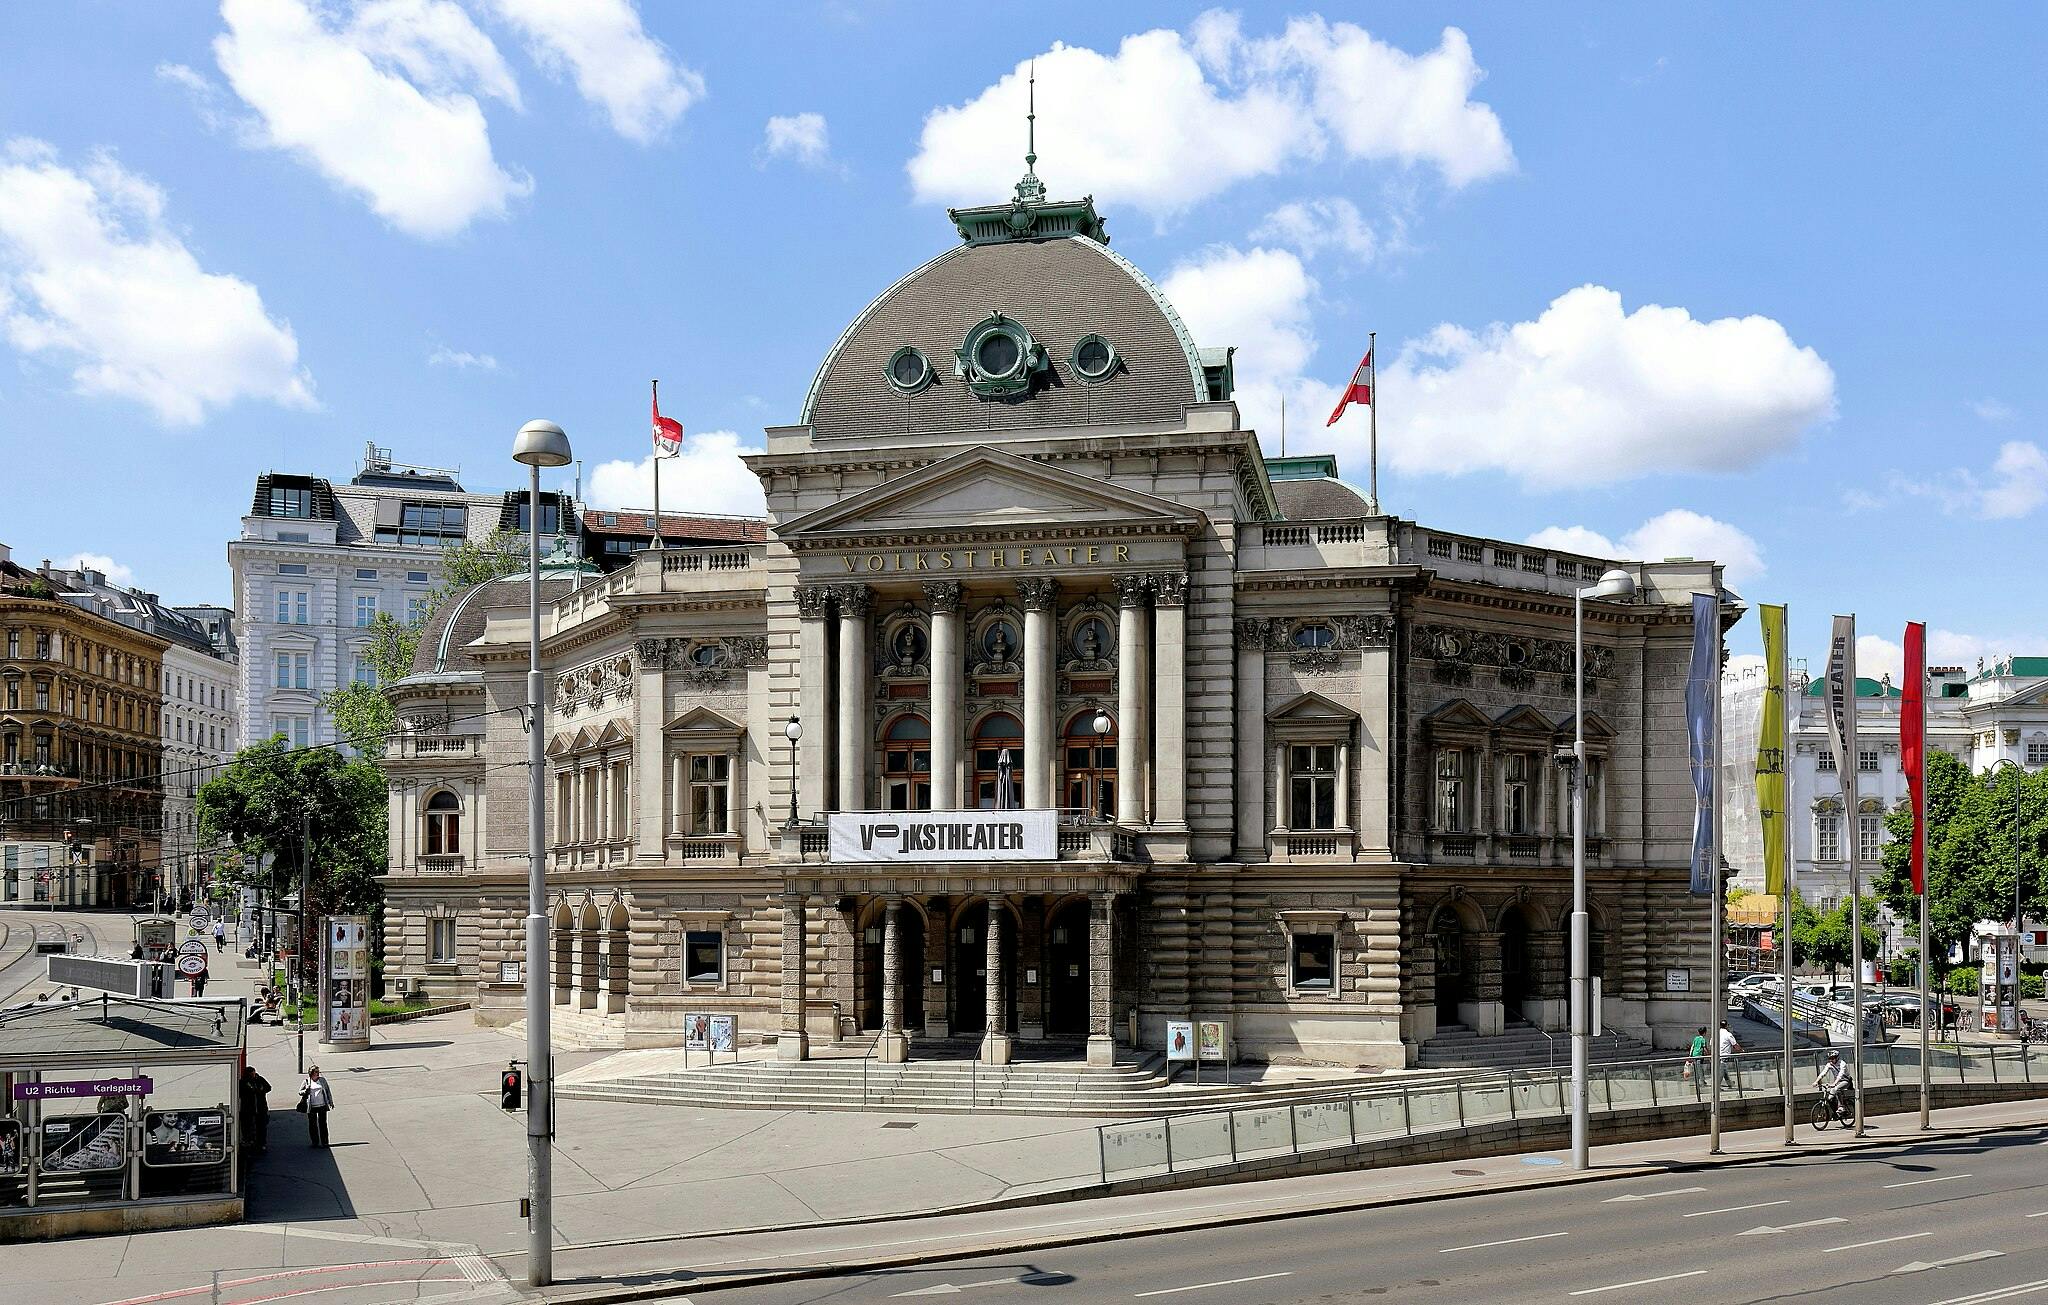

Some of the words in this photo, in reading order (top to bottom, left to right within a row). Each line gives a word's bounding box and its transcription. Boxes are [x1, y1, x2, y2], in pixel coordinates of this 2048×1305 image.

[843, 545, 1130, 572] VOLKSTHEATER
[860, 823, 1024, 853] VOLKSTHEATER
[25, 1087, 39, 1095] U2
[93, 1084, 142, 1093] Karlsplatz
